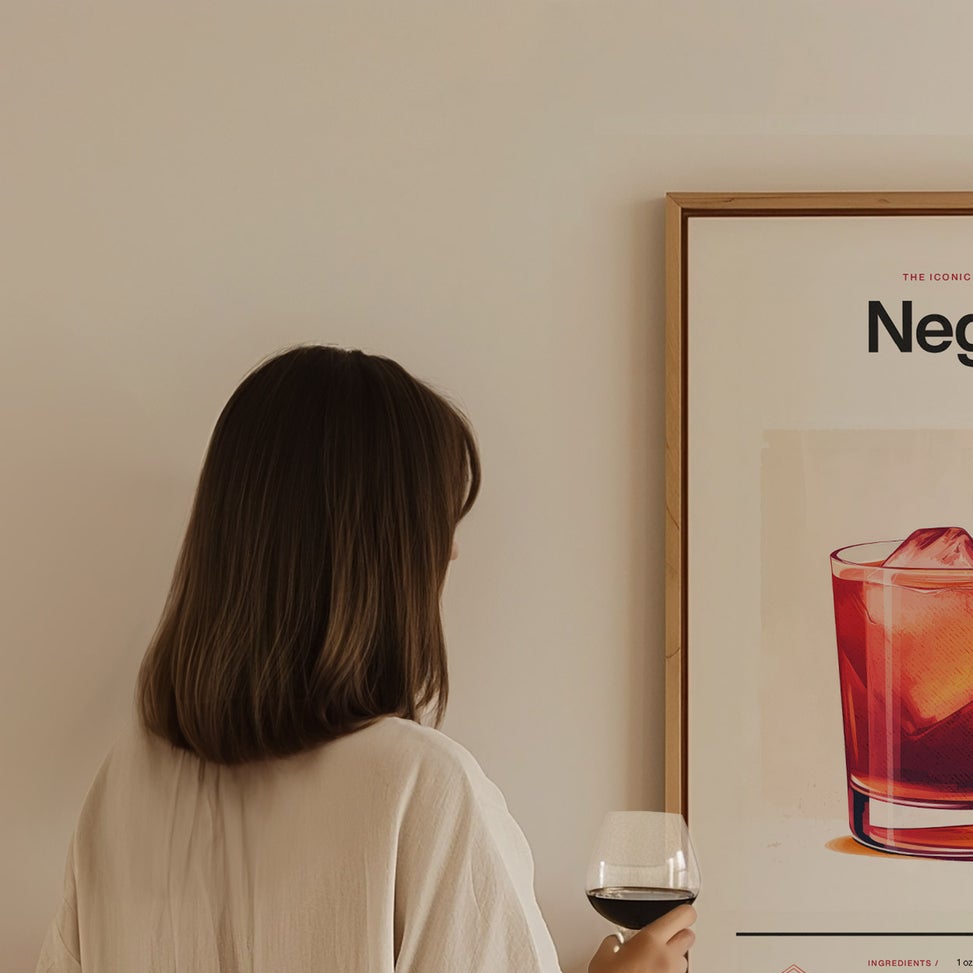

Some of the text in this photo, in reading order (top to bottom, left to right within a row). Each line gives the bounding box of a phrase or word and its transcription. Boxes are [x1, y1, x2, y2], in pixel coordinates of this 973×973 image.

[902, 273, 925, 281] THE
[930, 273, 971, 281] ICONIC
[957, 958, 960, 967] 1
[963, 959, 973, 967] oz
